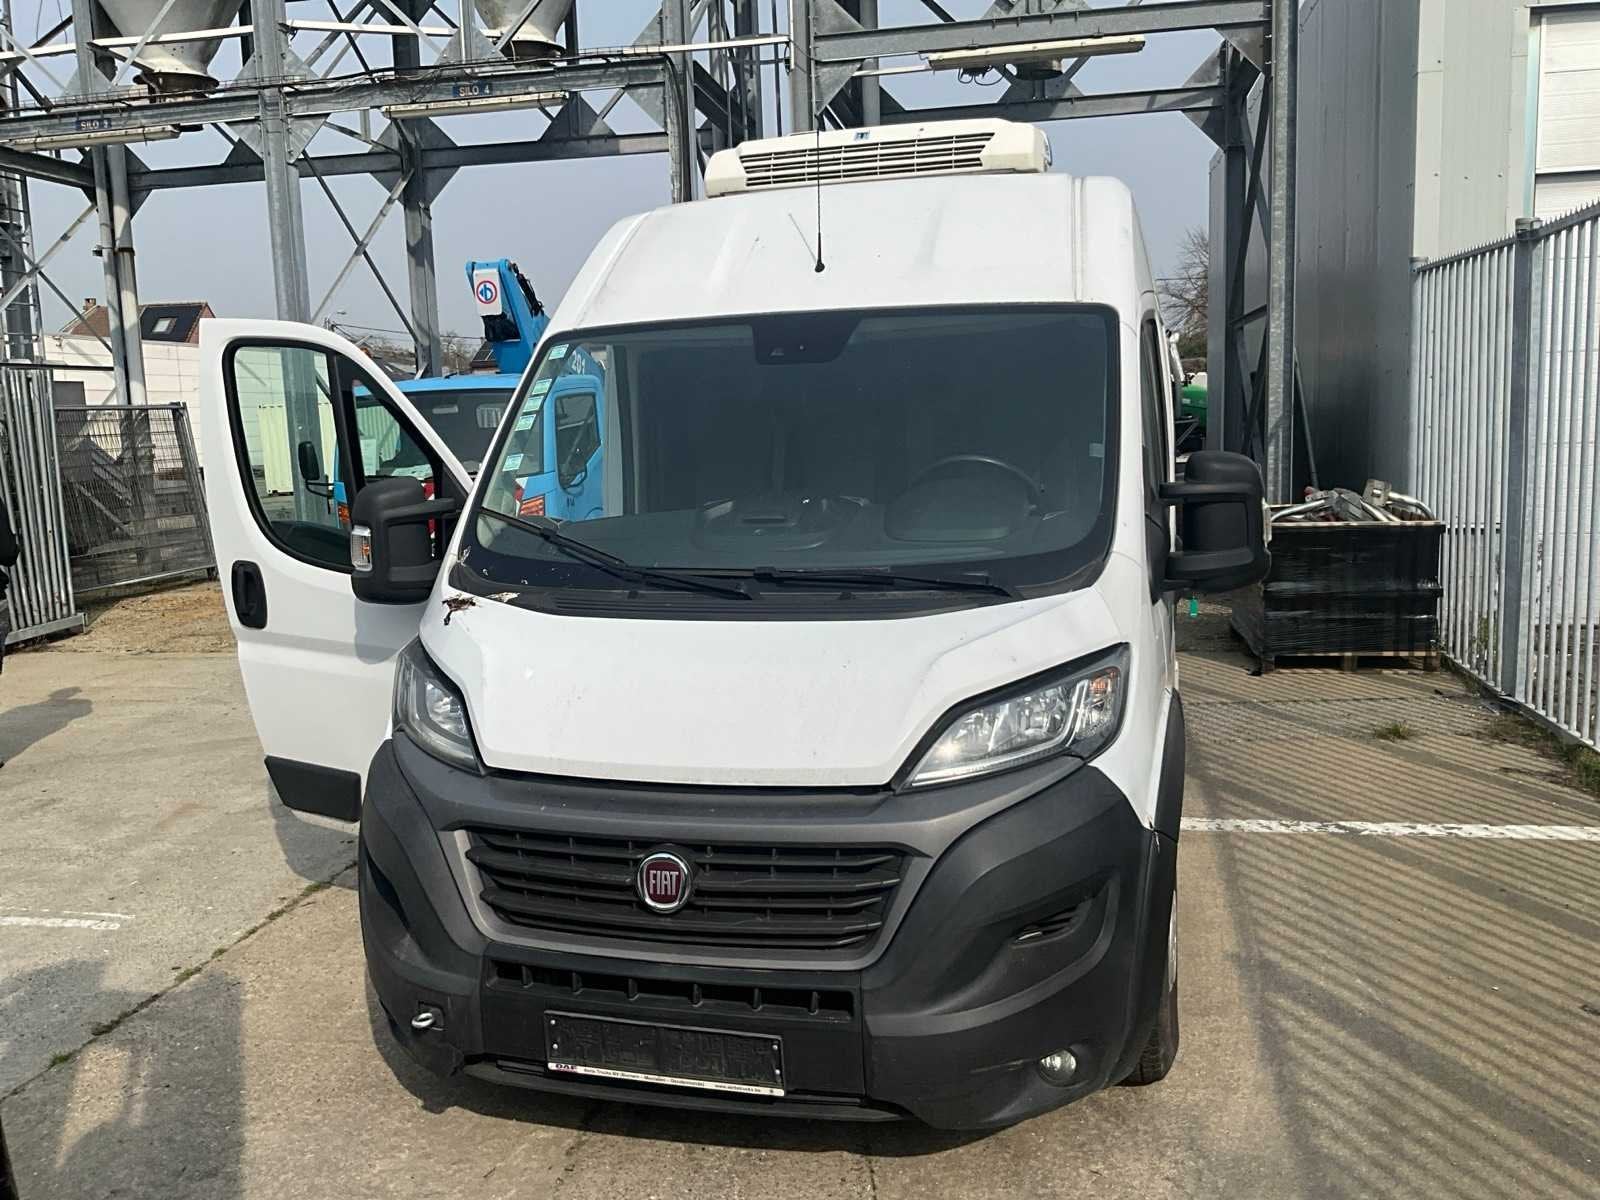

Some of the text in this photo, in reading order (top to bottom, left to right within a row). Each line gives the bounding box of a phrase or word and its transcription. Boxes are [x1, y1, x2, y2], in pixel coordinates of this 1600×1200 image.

[459, 85, 480, 97] SILO
[80, 119, 100, 130] SILO
[649, 870, 679, 896] FIAT
